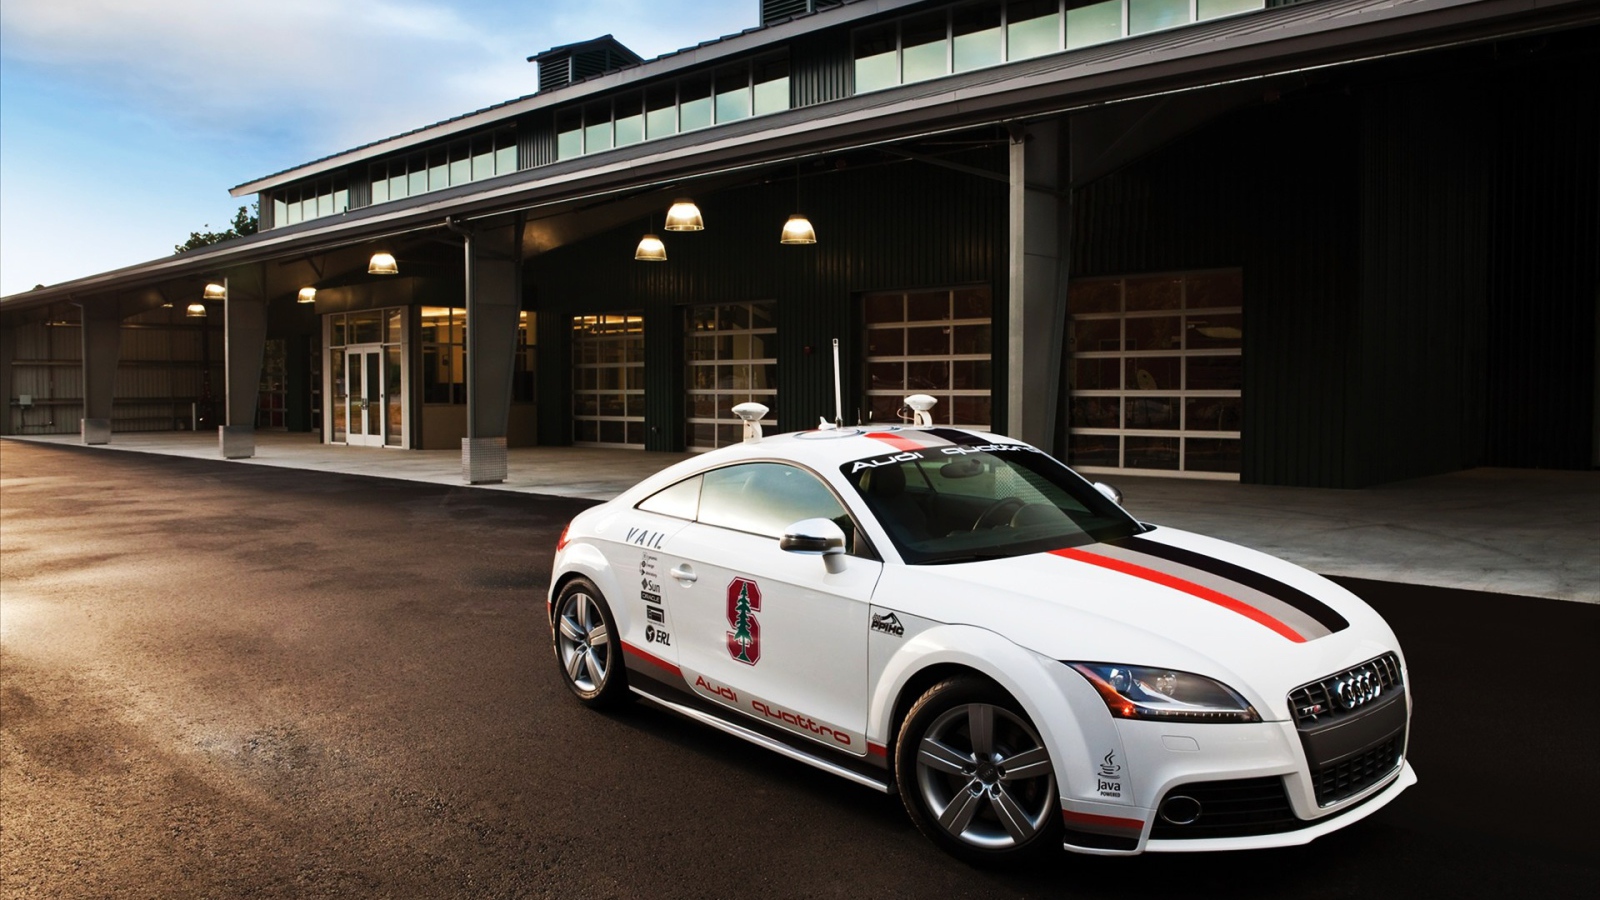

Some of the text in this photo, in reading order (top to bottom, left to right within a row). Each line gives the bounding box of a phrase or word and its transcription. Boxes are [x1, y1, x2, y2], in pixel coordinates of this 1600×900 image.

[625, 527, 665, 549] VAIL
[648, 579, 661, 593] Sun
[726, 576, 762, 666] S
[871, 620, 905, 636] PPIHC
[656, 629, 671, 646] ERL
[695, 675, 852, 745] Audi quattro
[1097, 779, 1121, 791] Java
